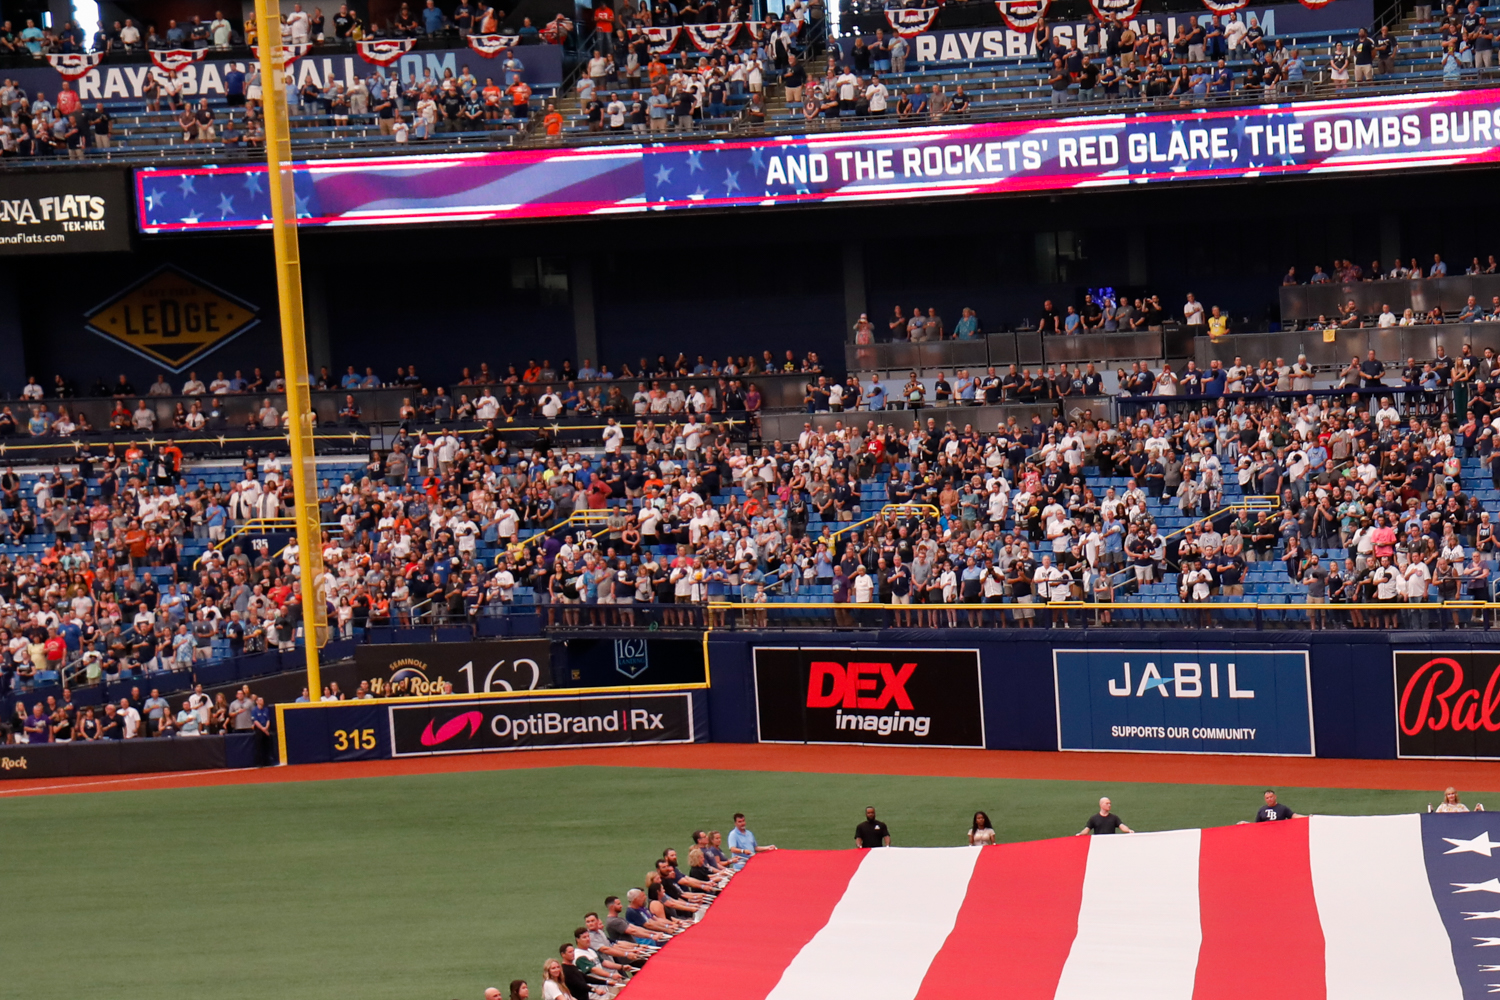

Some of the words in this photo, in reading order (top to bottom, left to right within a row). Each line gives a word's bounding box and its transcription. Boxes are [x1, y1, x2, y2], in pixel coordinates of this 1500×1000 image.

[766, 154, 828, 184] AND
[835, 150, 895, 181] THE
[903, 139, 1049, 178] ROCKETS'
[1059, 134, 1119, 167] RED
[1128, 128, 1239, 163] GLARE,
[1245, 122, 1306, 156] THE
[1314, 115, 1420, 153] BOMBS
[0, 199, 41, 225] NA
[39, 194, 105, 221] FLATS
[62, 220, 105, 232] TEX-MEX
[124, 299, 220, 338] LEDGE
[251, 539, 269, 551] 135
[617, 639, 645, 659] 162
[389, 658, 427, 670] SEMINOLE
[458, 658, 540, 694] 162
[410, 675, 446, 697] Rock
[806, 661, 918, 710] DEX
[1108, 662, 1255, 698] JABIL
[491, 709, 627, 741] OptiBrand
[631, 708, 665, 731] Rx
[836, 709, 931, 737] imaging
[1111, 725, 1166, 739] SUPPORTS
[1167, 726, 1190, 739] OUR
[1192, 726, 1256, 740] COMMUNITY
[334, 728, 377, 751] 315
[1, 756, 27, 771] Rock
